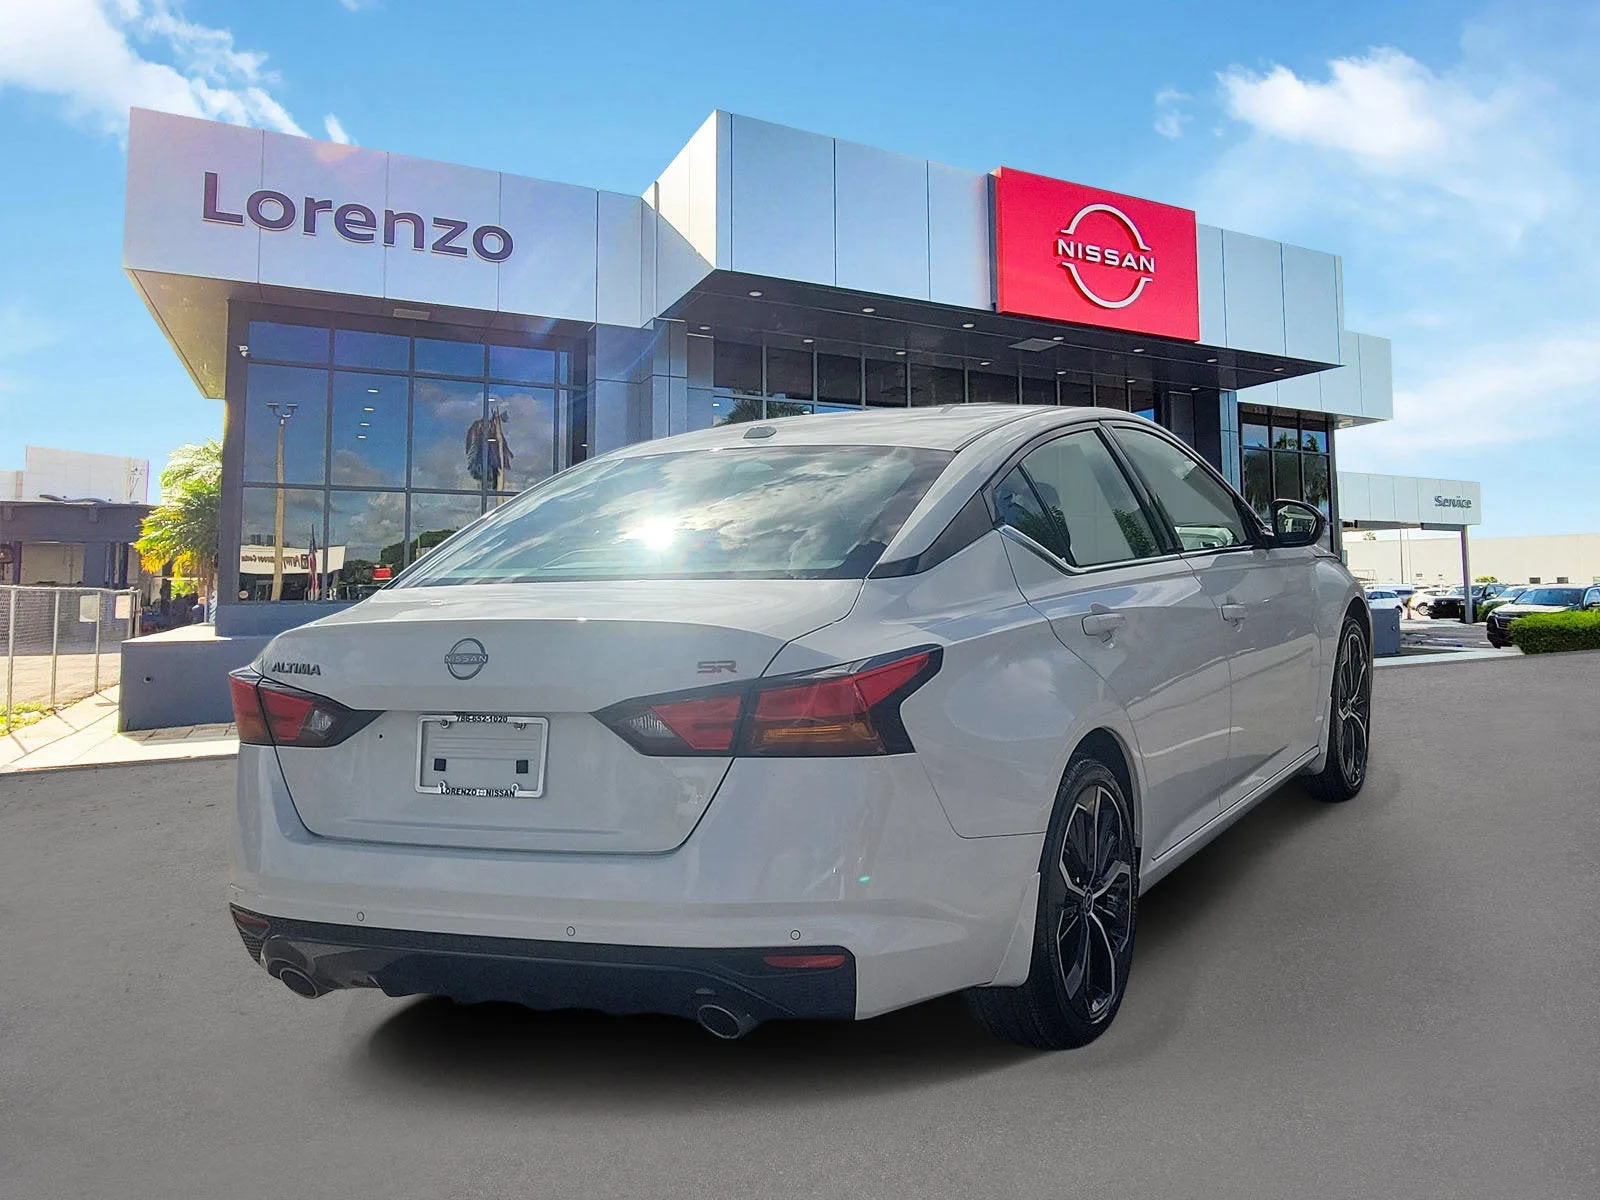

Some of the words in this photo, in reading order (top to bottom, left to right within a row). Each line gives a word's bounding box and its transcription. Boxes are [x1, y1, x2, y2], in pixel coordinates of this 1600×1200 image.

[202, 171, 514, 262] Lorenzo
[1057, 238, 1156, 273] NISSAN
[1434, 495, 1472, 509] Service
[444, 654, 488, 664] NISSAN
[271, 661, 321, 676] ALTIMA
[697, 660, 738, 674] SR
[440, 786, 477, 796] LORENZO
[485, 788, 515, 798] NISSAN
